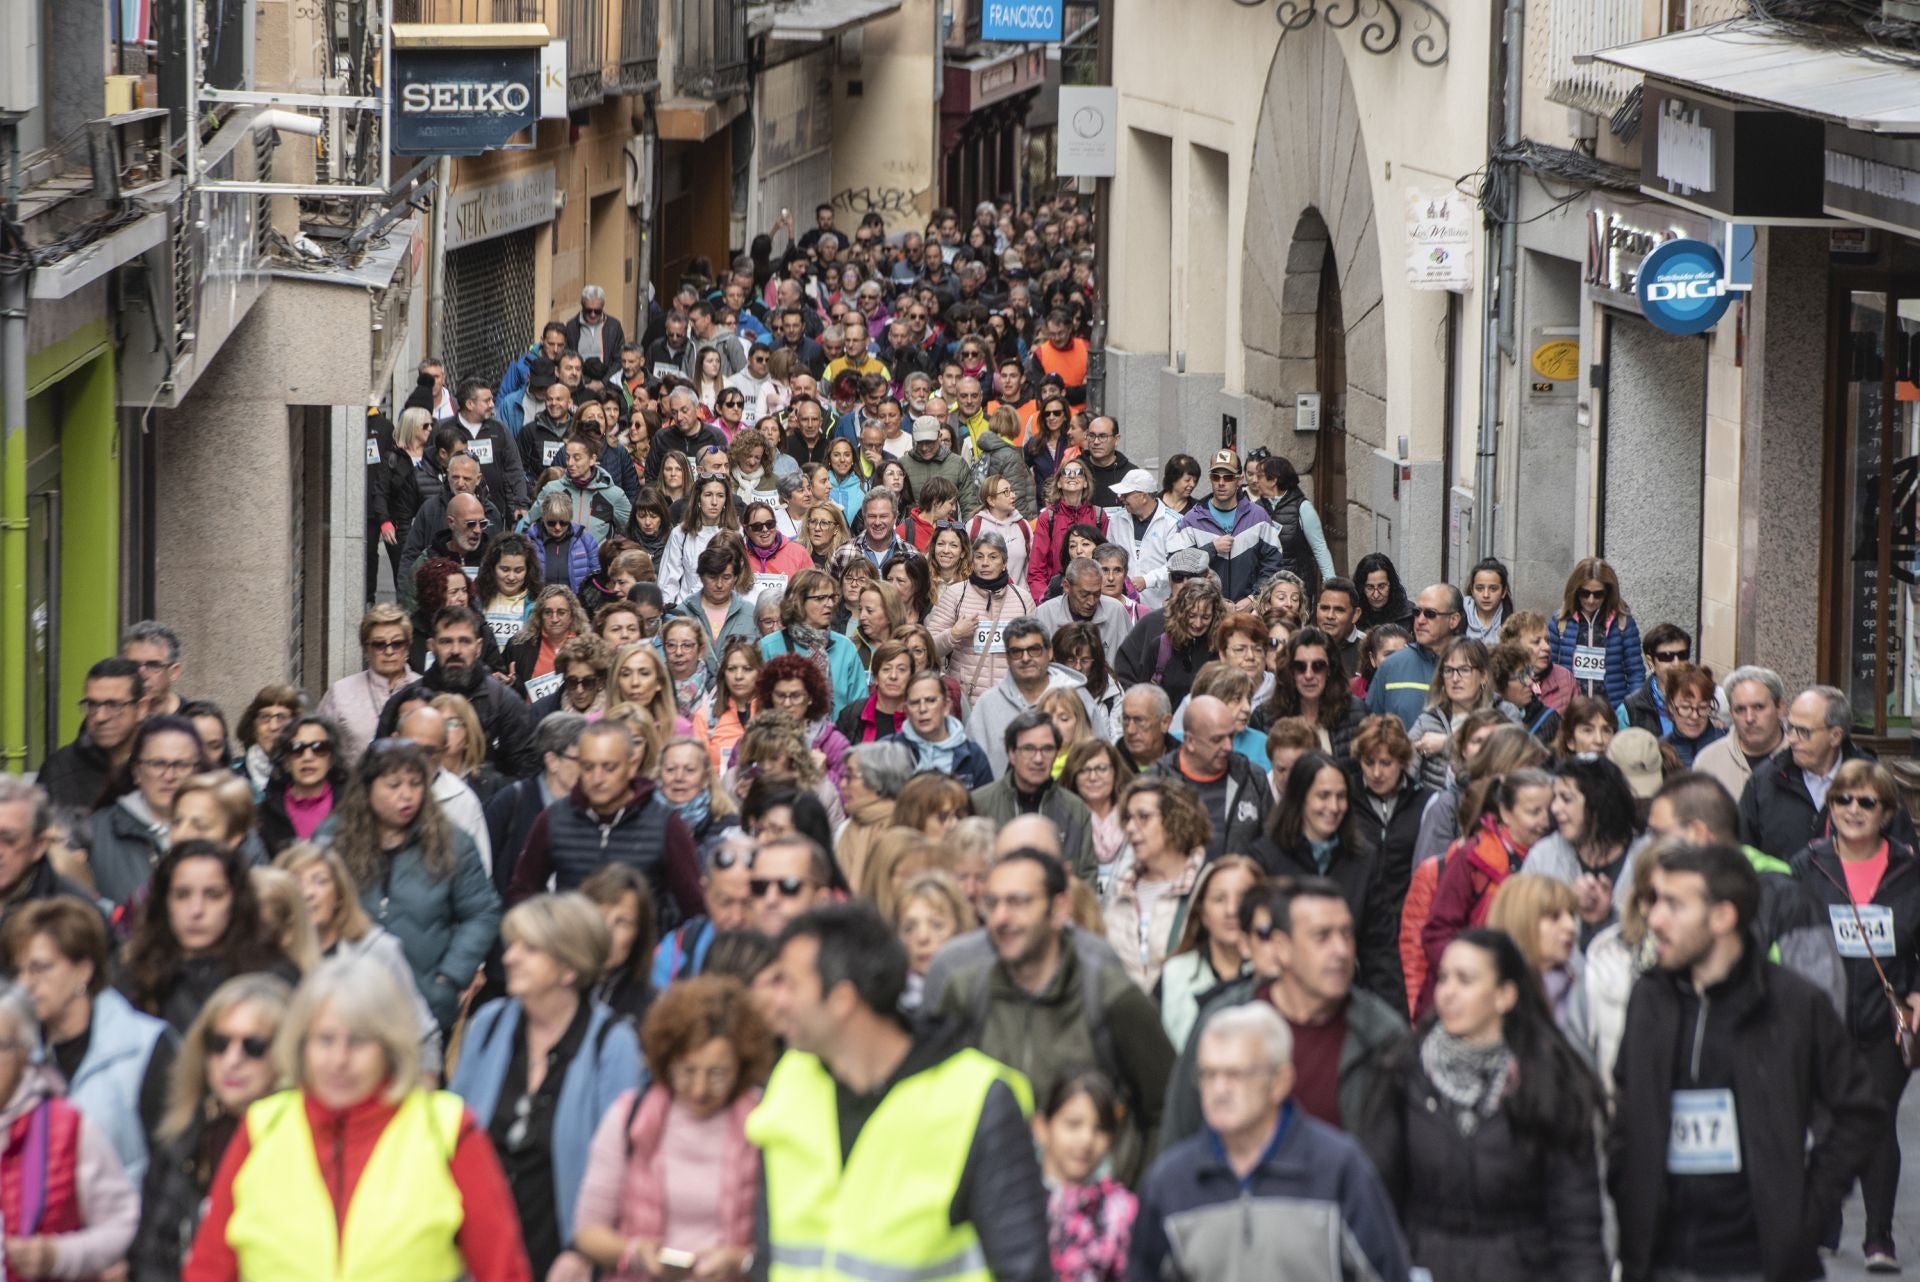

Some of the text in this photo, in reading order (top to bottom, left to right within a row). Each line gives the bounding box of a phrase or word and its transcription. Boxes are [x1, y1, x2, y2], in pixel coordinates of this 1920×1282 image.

[989, 4, 1054, 29] FRANCISCO
[402, 82, 530, 112] SEIKO
[1657, 271, 1716, 283] Distribuidor oficial
[1647, 279, 1726, 302] DIGI
[1574, 656, 1605, 670] 6299
